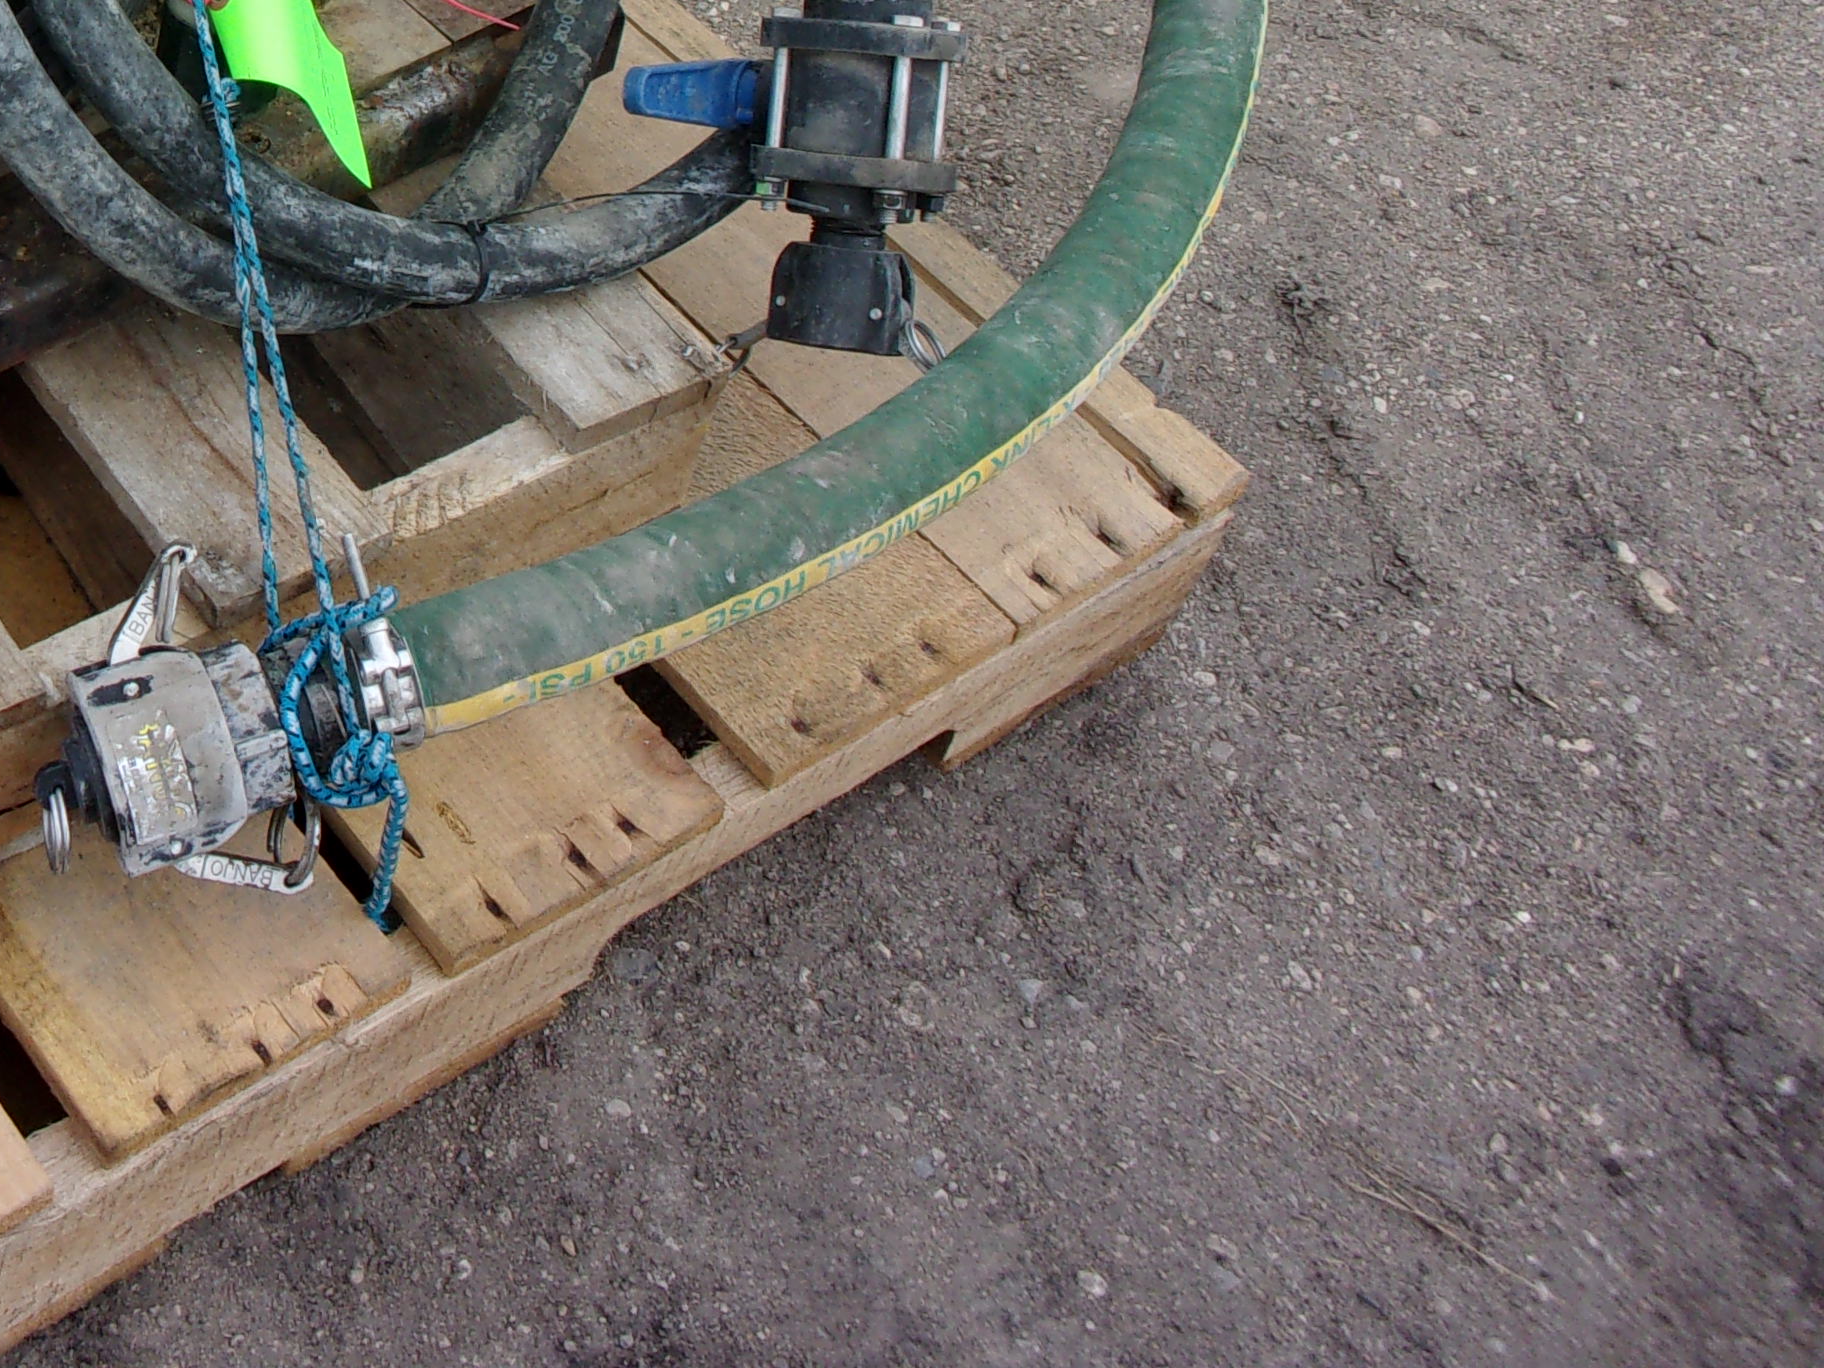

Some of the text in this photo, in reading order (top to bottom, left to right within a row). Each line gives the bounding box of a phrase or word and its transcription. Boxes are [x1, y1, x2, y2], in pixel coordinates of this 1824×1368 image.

[537, 51, 559, 76] AG
[553, 14, 576, 43] 200
[819, 469, 982, 580] CHEMICAL
[706, 571, 806, 633] HOSE
[605, 635, 666, 674] 150
[529, 663, 592, 704] PSI
[210, 858, 274, 888] BANJO
